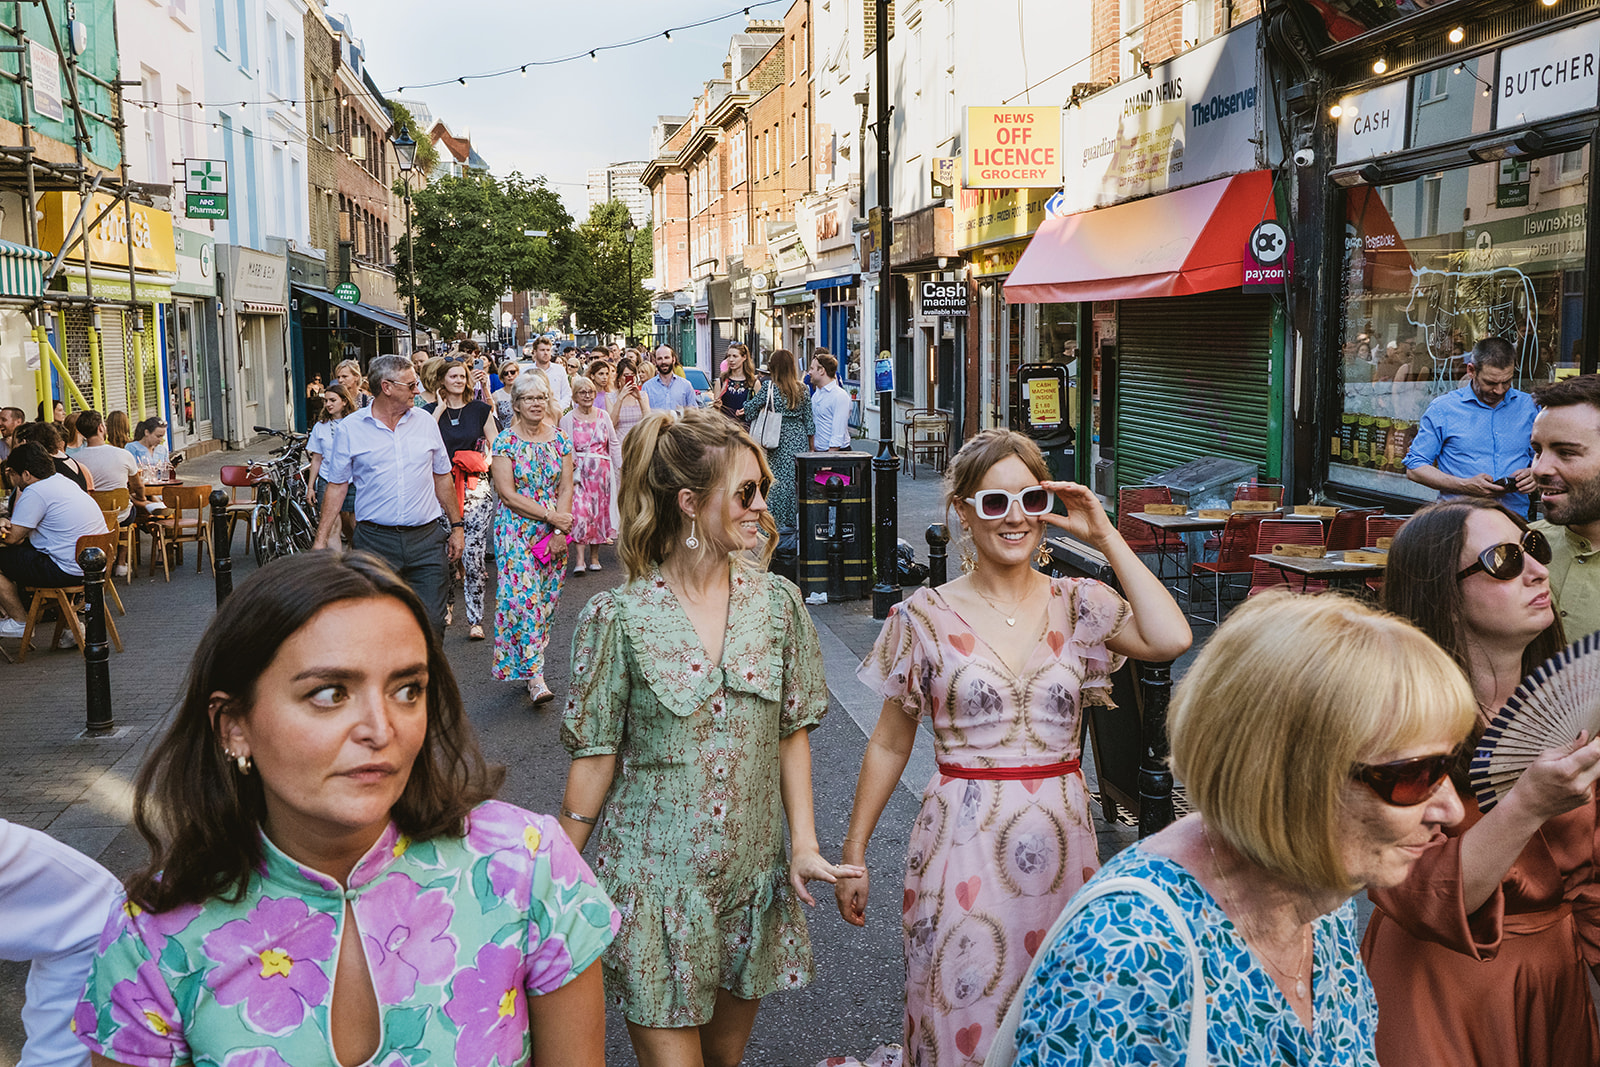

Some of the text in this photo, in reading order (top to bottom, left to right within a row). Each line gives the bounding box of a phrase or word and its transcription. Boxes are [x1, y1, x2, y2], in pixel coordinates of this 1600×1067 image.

[1504, 53, 1594, 98] BUTCHER
[1123, 77, 1183, 118] ANAND NEWS
[994, 113, 1034, 123] NEWS
[1353, 109, 1390, 135] CASH
[996, 127, 1031, 145] OFF
[974, 148, 1054, 166] LICENCE
[1082, 137, 1116, 168] guardian
[981, 169, 1047, 179] GROCERY
[190, 206, 225, 216] Pharmacy
[923, 282, 966, 297] Cash
[923, 297, 966, 306] machine
